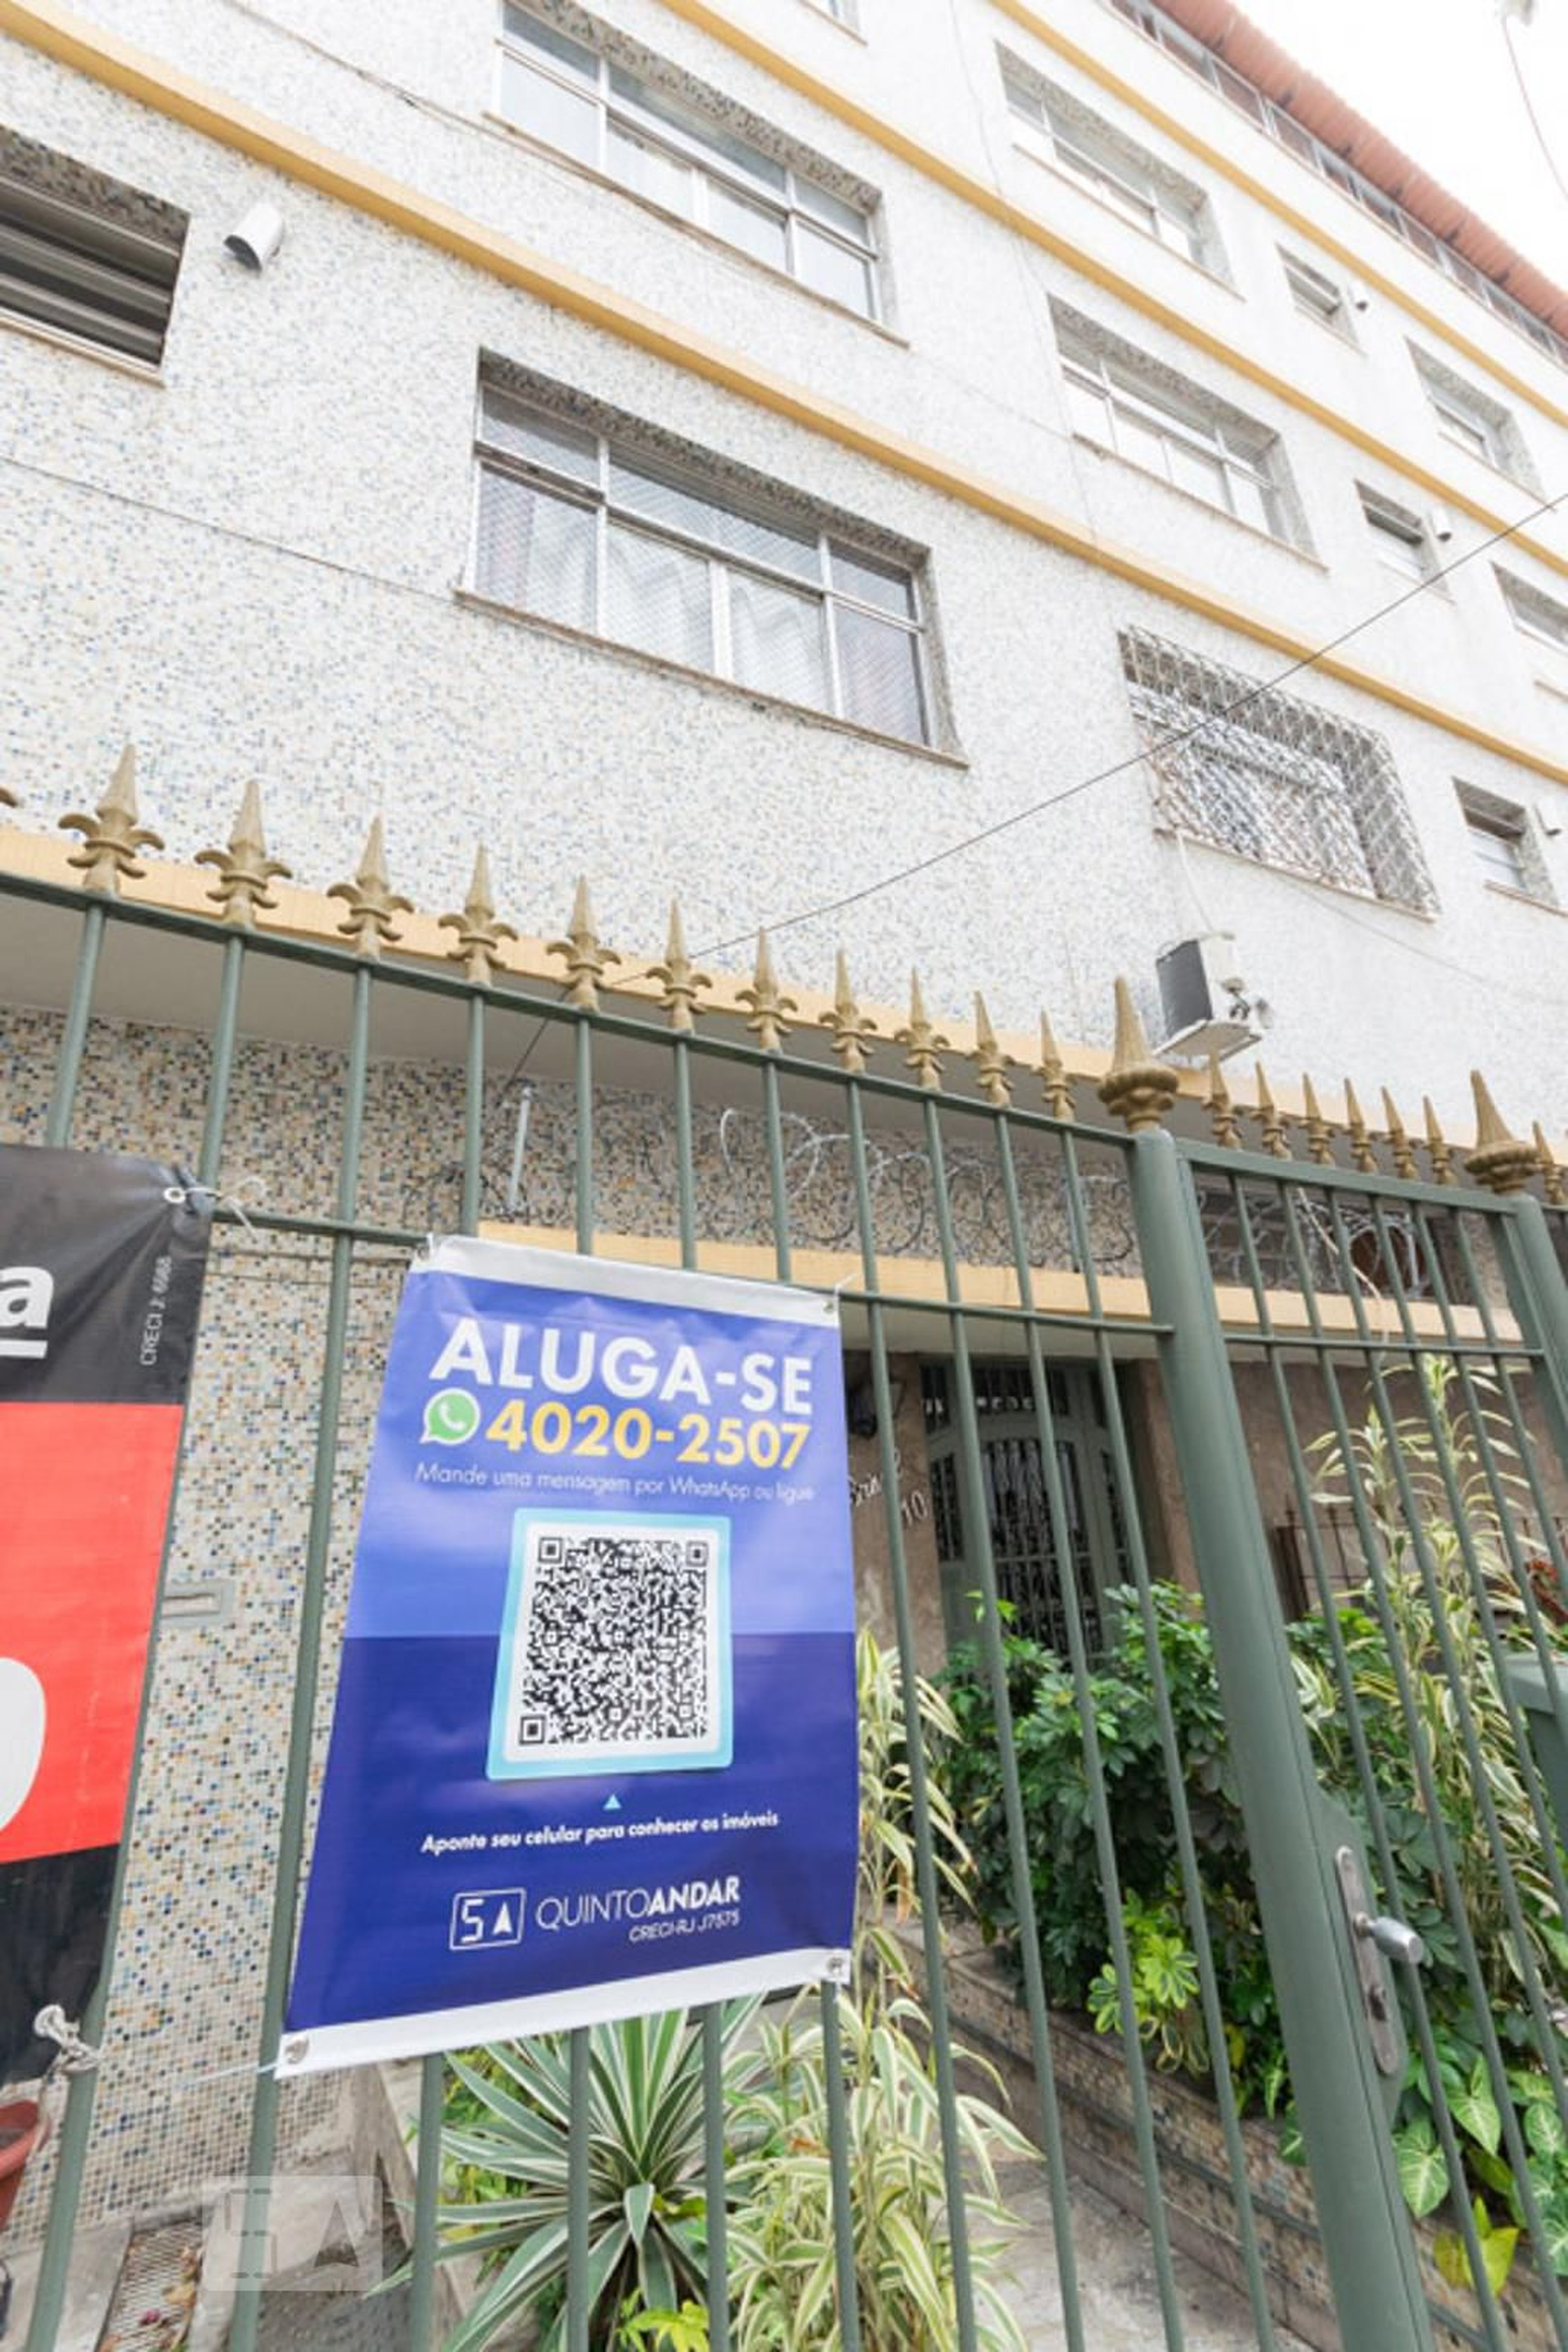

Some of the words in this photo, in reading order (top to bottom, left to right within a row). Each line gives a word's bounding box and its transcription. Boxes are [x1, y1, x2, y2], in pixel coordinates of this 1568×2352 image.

[140, 1313, 163, 1366] CRECI
[428, 1317, 813, 1415] ALUGA-SE
[485, 1399, 812, 1469] 4020-2507
[415, 1461, 488, 1486] Mande
[493, 1471, 531, 1488] uma
[538, 1472, 630, 1496] mensagem
[634, 1478, 664, 1496] por
[668, 1474, 751, 1502] WhatsApp
[753, 1486, 775, 1501] ou
[776, 1481, 815, 1506] ligue
[421, 1834, 487, 1857] Aponte
[491, 1833, 521, 1848] seu
[526, 1825, 583, 1845] celular
[585, 1824, 625, 1845] para
[628, 1817, 699, 1836] conhecer
[700, 1817, 719, 1831] os
[722, 1809, 779, 1830] imóveis
[535, 1875, 741, 1930] QUINTOANDAR
[628, 1917, 695, 1942] CRECI-RJ
